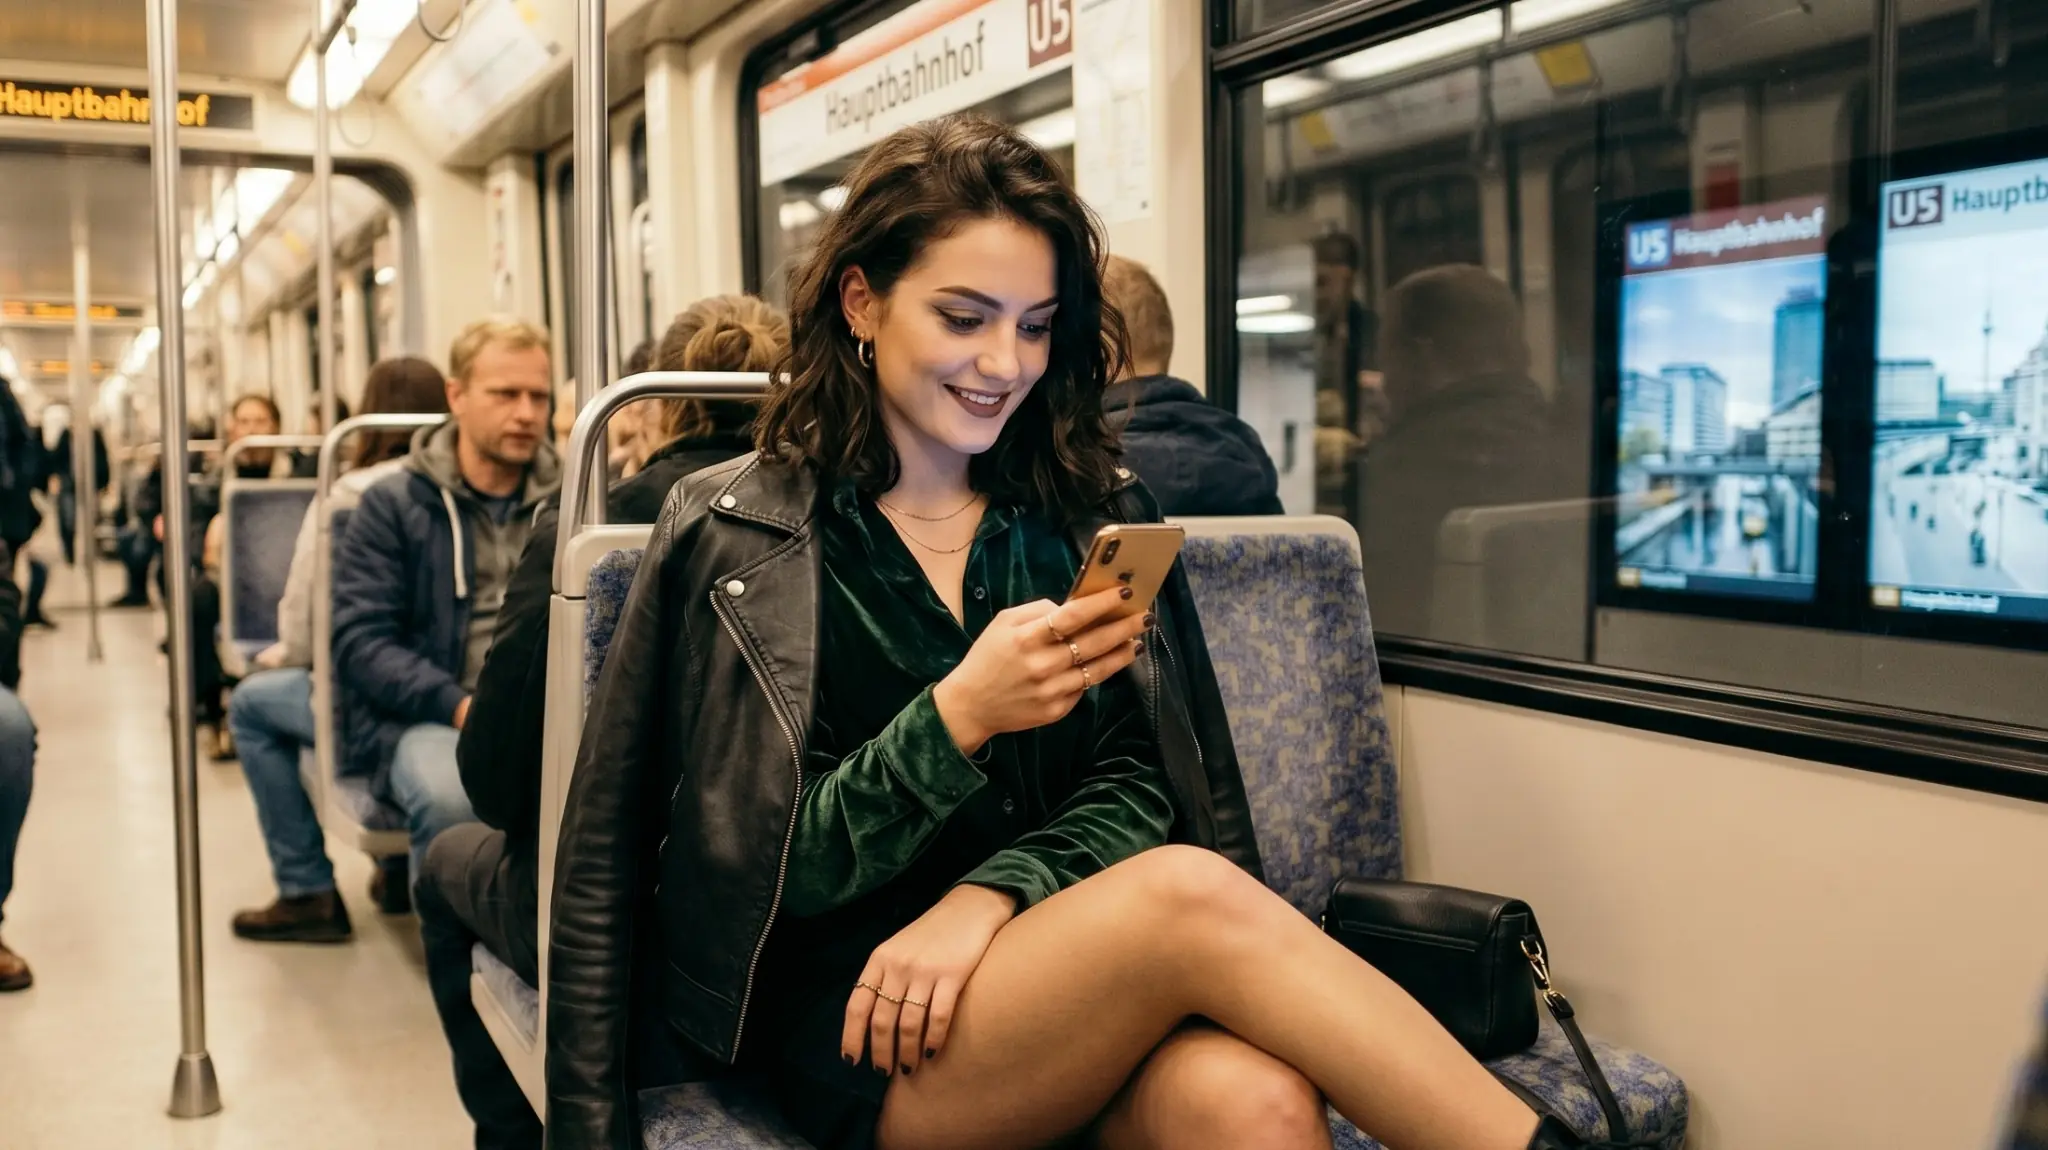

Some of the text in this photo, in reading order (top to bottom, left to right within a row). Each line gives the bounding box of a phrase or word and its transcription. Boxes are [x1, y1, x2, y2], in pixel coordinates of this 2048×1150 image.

[825, 0, 1071, 136] Hauptbahnhof U5
[0, 81, 210, 127] Hauptbahnof
[1892, 187, 1940, 226] U5
[1630, 228, 1668, 264] U5
